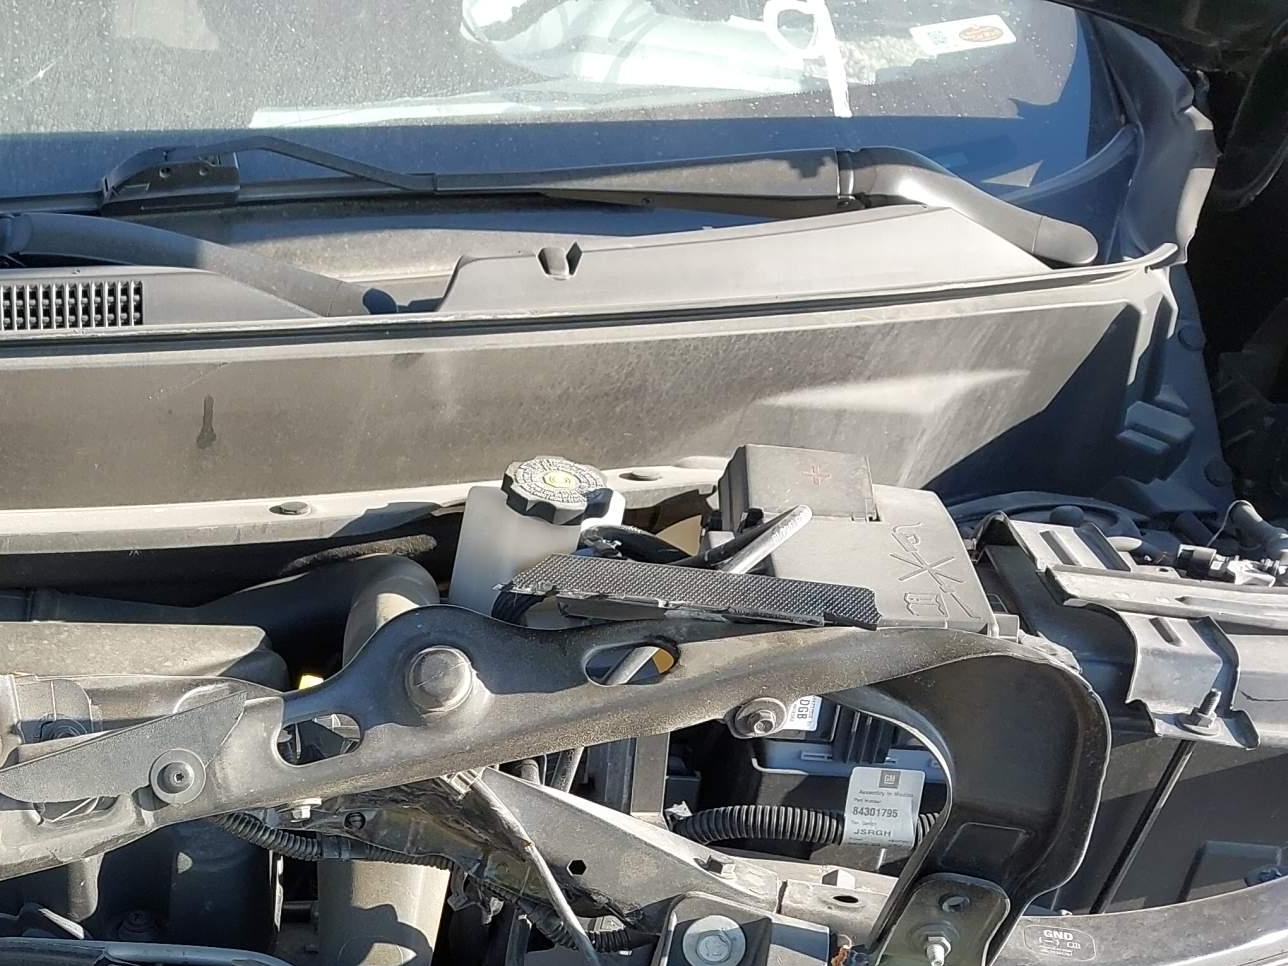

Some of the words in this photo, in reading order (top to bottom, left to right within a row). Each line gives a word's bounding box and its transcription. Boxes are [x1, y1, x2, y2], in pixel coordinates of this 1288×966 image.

[884, 774, 896, 784] GM
[853, 806, 898, 817] 84301795
[854, 828, 891, 837] JSRGH
[1043, 929, 1073, 941] GND
